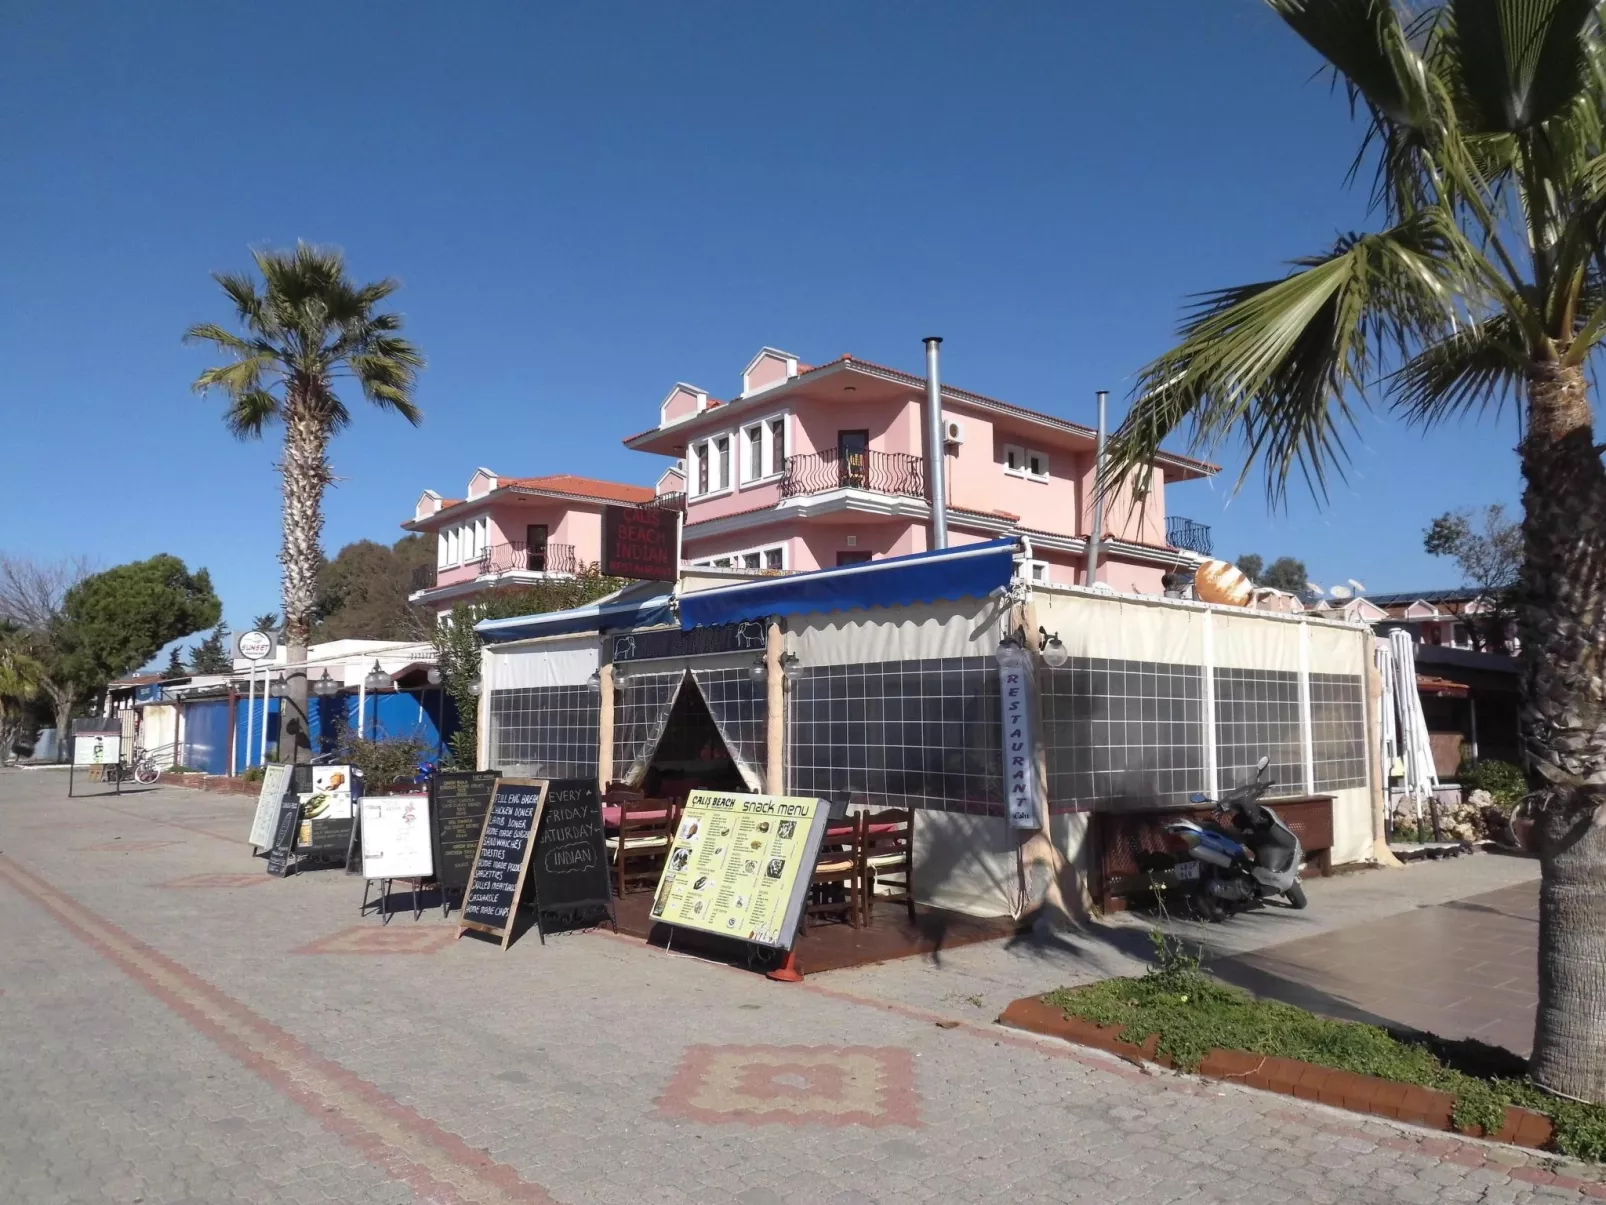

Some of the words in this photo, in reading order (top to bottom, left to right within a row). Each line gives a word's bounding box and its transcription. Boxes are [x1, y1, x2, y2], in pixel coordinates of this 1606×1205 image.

[618, 524, 666, 546] BEACH
[616, 542, 669, 564] INDIAN
[241, 643, 269, 652] SUNSET
[1006, 674, 1027, 807] RESTAURANT
[549, 789, 581, 803] EVERY
[547, 805, 588, 824] FRIDAY
[712, 797, 736, 807] BEACH
[742, 800, 775, 813] snack
[777, 803, 810, 816] menu
[554, 848, 592, 866] INDIAN
